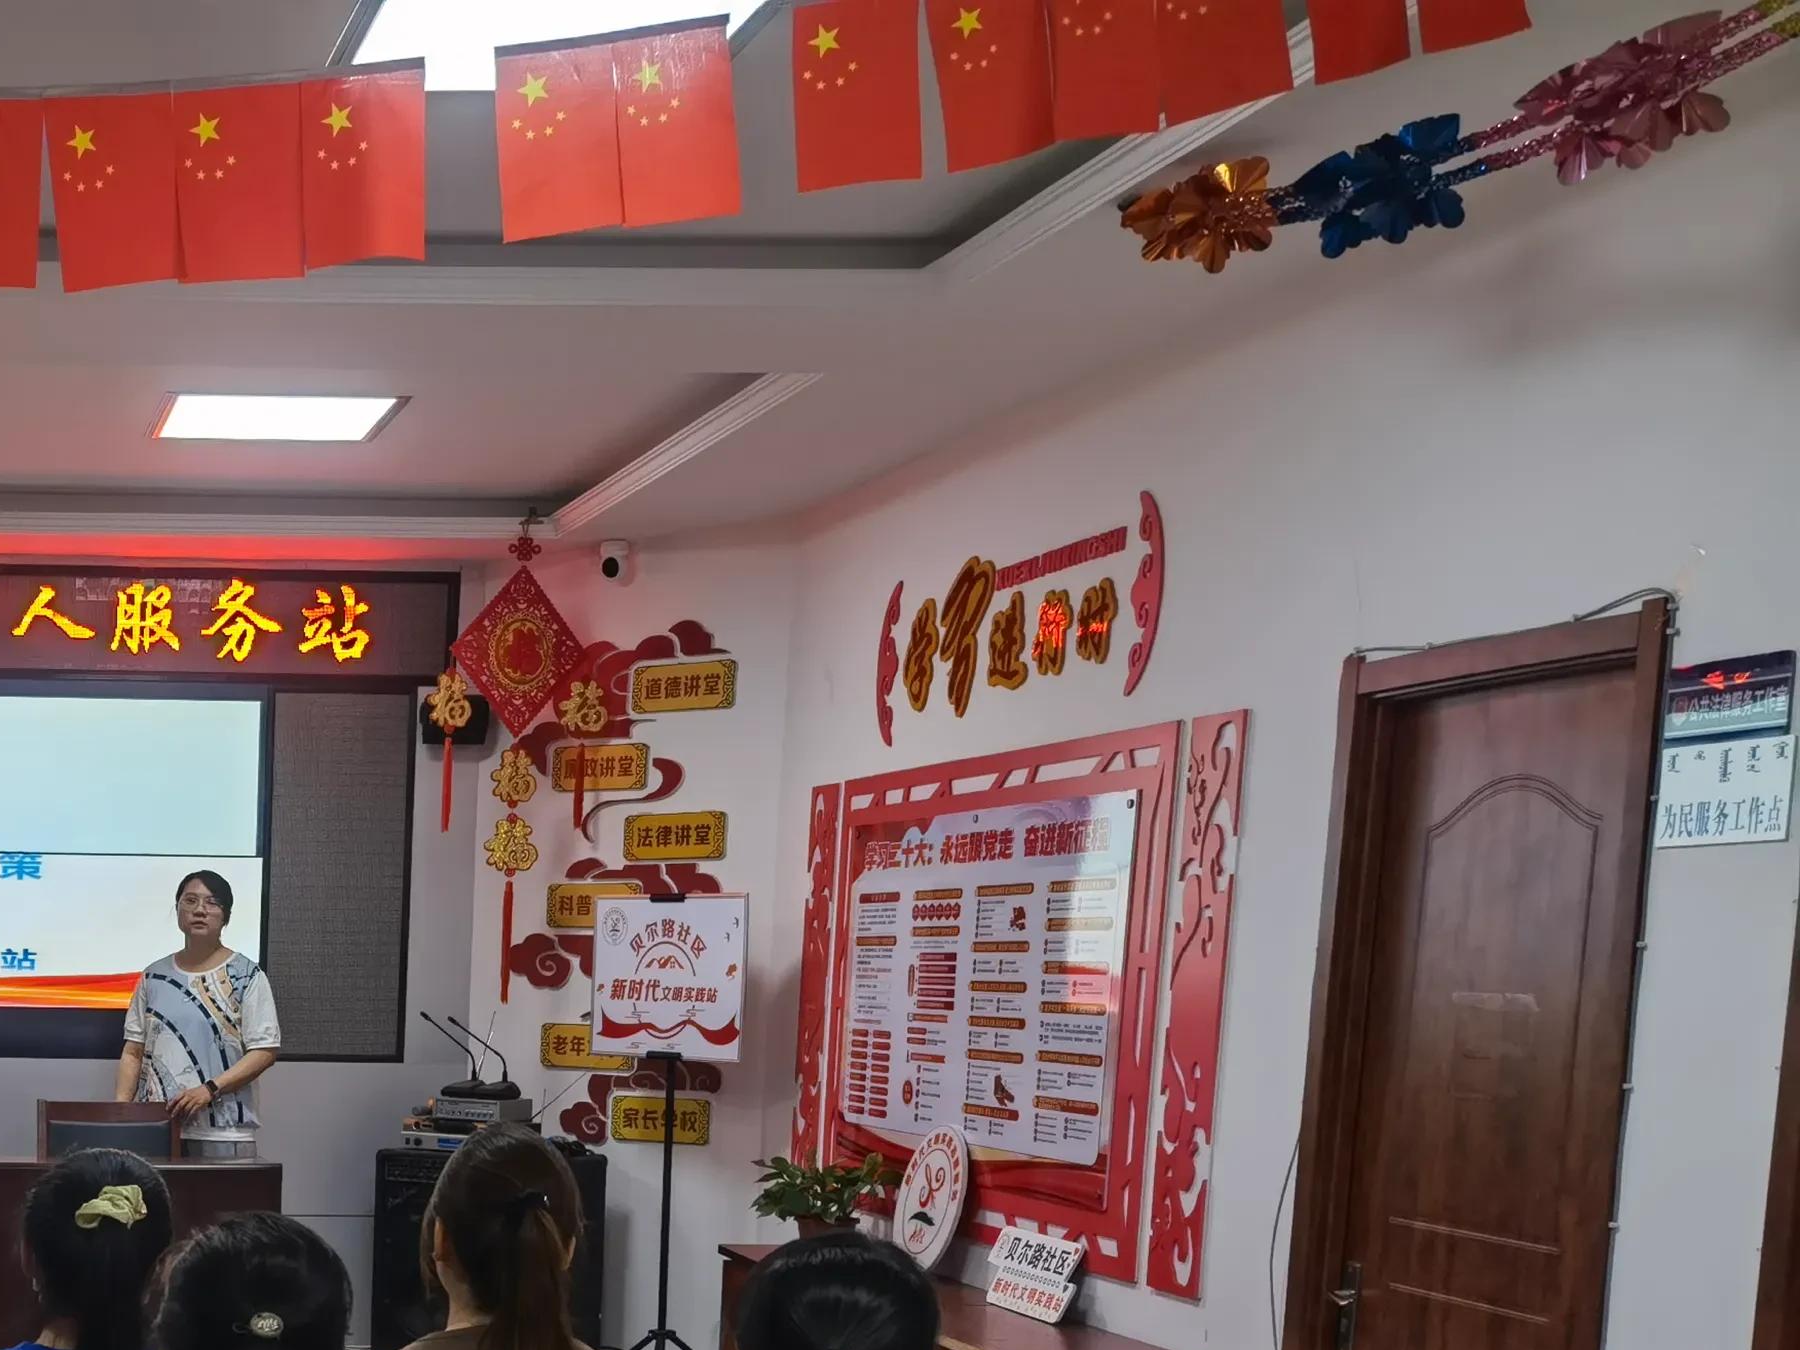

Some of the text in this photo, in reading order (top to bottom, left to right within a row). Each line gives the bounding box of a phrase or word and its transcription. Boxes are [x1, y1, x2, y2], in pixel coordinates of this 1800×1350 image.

[903, 555, 1118, 718] 学习进行时
[643, 672, 722, 701] 道德讲堂
[636, 822, 712, 848] 法律讲堂
[1659, 794, 1784, 840] 为民服务工作点
[629, 918, 708, 960] 贝尔路社区
[609, 978, 719, 1004] 新时代文明实践站
[1003, 1236, 1073, 1276] 贝尔路社区
[991, 1277, 1065, 1314] 新时代文明实践站
